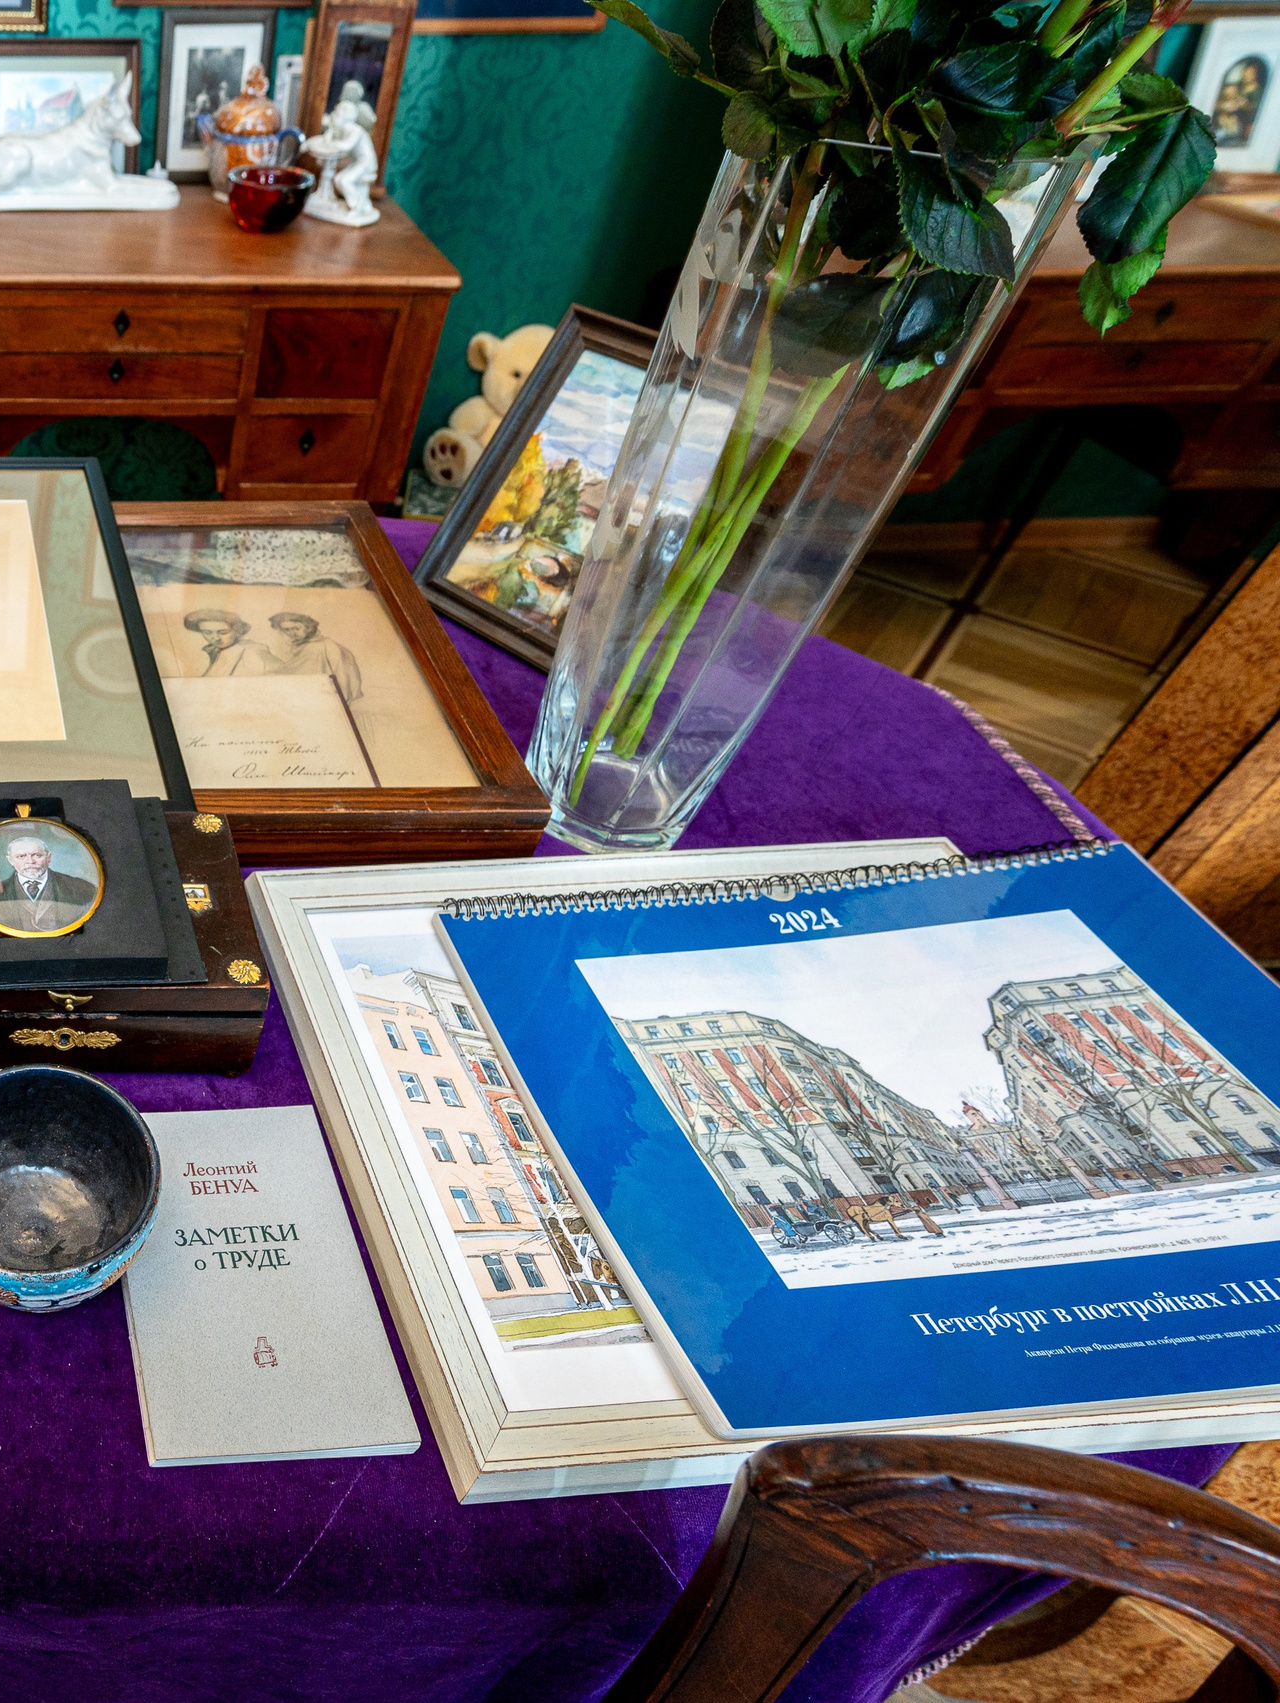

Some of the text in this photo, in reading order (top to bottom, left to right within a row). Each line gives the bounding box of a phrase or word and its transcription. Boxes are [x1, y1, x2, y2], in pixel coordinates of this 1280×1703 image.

[768, 907, 843, 935] 2024
[182, 1160, 259, 1177] Леонтий
[189, 1178, 260, 1196] БЕНУА
[174, 1223, 300, 1247] ЗАМЕТКИ
[194, 1248, 291, 1271] о ТРУДЕ
[909, 1277, 1280, 1336] Петербург в постройках Л.Н
[1024, 1347, 1065, 1358] Акварели
[1063, 1345, 1093, 1355] Петра
[1156, 1334, 1197, 1347] собрания
